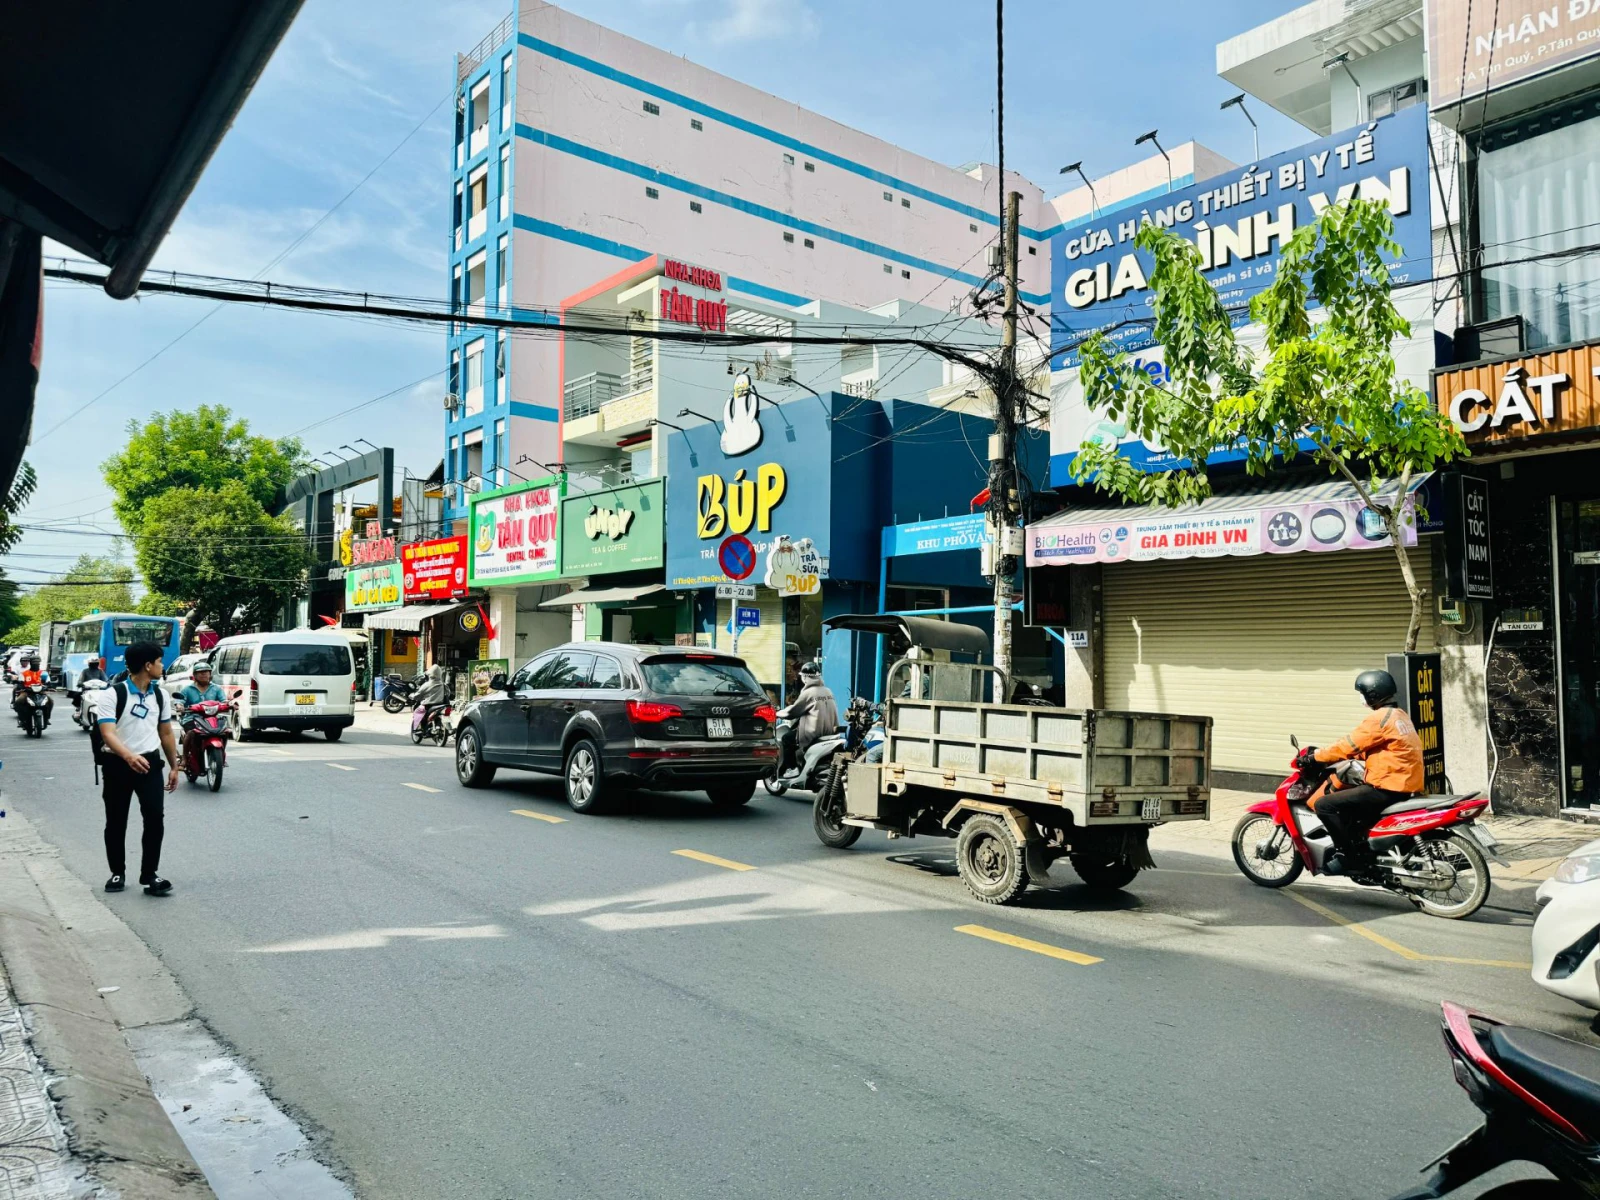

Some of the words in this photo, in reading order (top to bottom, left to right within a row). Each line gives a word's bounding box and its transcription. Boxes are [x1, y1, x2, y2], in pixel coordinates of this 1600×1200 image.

[1475, 6, 1559, 57] NHẬN
[1064, 225, 1115, 260] CỬA
[1117, 199, 1194, 249] HÀNG
[1197, 167, 1273, 217] THIẾT
[1278, 159, 1305, 191] BỊ
[1308, 150, 1330, 178] Y
[1334, 123, 1379, 176] TẾ
[1064, 252, 1151, 310] GIA
[1180, 202, 1293, 272] ÌNH
[665, 258, 690, 284] NHA
[690, 265, 722, 292] KHOA
[660, 286, 694, 325] TÂN
[696, 298, 727, 333] QUÝ
[1449, 366, 1567, 433] CẮT
[504, 495, 522, 513] NHA
[525, 488, 551, 510] KHOA
[698, 462, 786, 540] BÚP
[1467, 489, 1484, 512] CẮT
[497, 515, 524, 550] TÂN
[528, 505, 558, 546] QUÝ
[1174, 521, 1191, 530] THIẾT
[1468, 515, 1485, 537] TÓC
[917, 538, 941, 550] KHU
[943, 531, 967, 547] PHỐ
[1141, 534, 1168, 549] GIA
[1174, 529, 1217, 547] ĐÌNH
[1223, 528, 1248, 544] VN
[701, 546, 715, 559] TRÀ
[800, 552, 817, 564] TRÀ
[1468, 544, 1488, 561] NAM
[785, 574, 818, 593] BÚP
[1071, 632, 1085, 641] 11A
[1417, 660, 1433, 694] CẮT
[1418, 694, 1435, 723] TÓC
[1417, 726, 1438, 751] NAM
